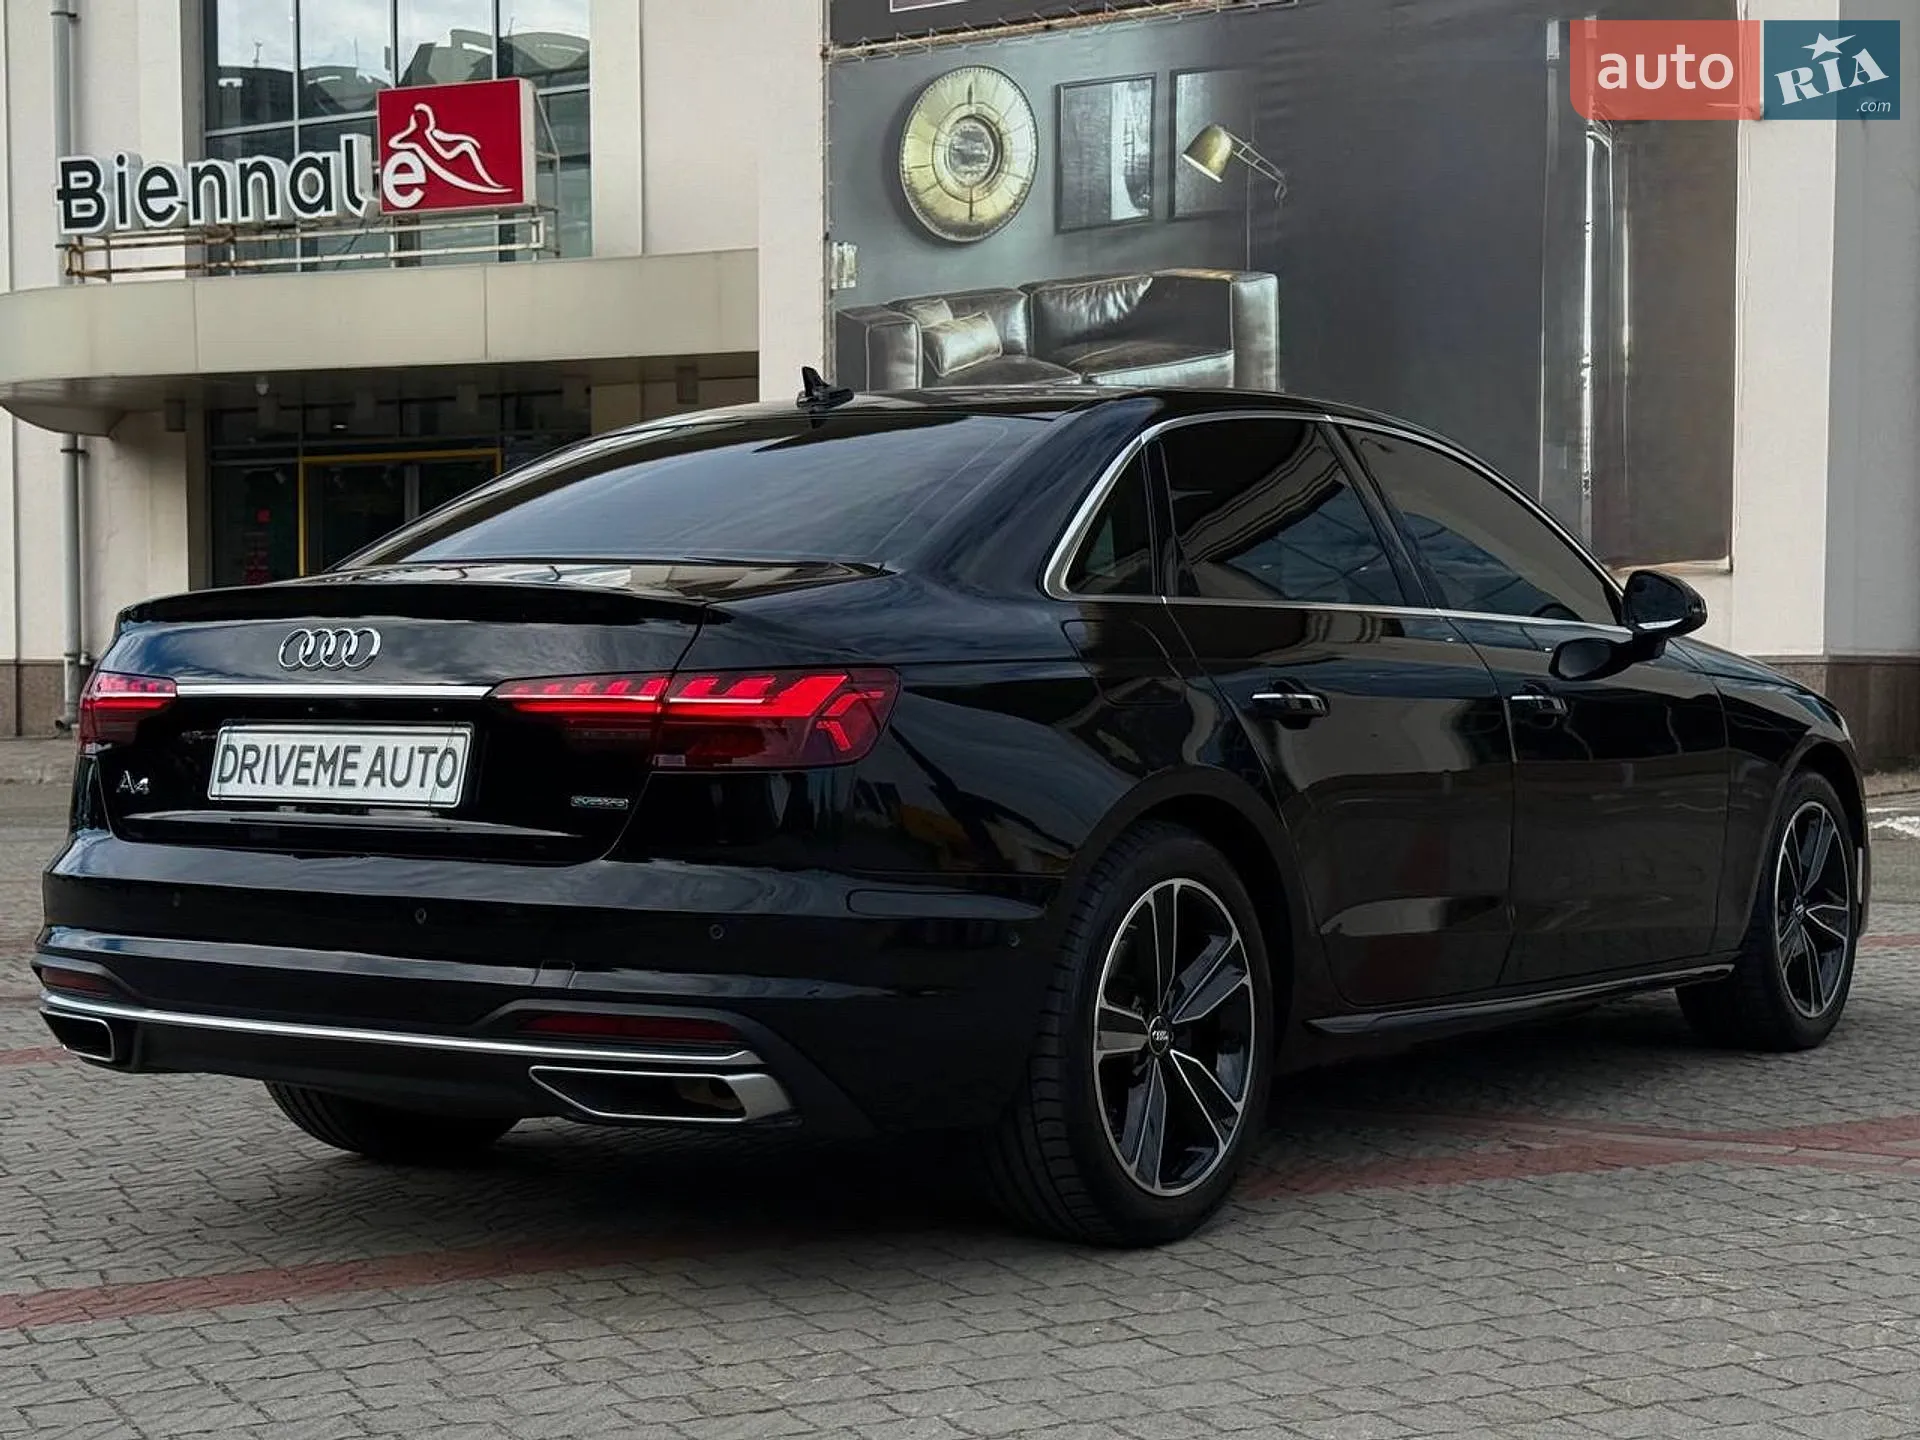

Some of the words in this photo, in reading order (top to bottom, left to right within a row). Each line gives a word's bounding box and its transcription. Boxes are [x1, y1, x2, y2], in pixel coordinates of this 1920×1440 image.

[57, 134, 427, 232] Biennale
[115, 769, 150, 795] A4
[217, 743, 362, 787] DRIVEME
[363, 745, 459, 789] AUTO
